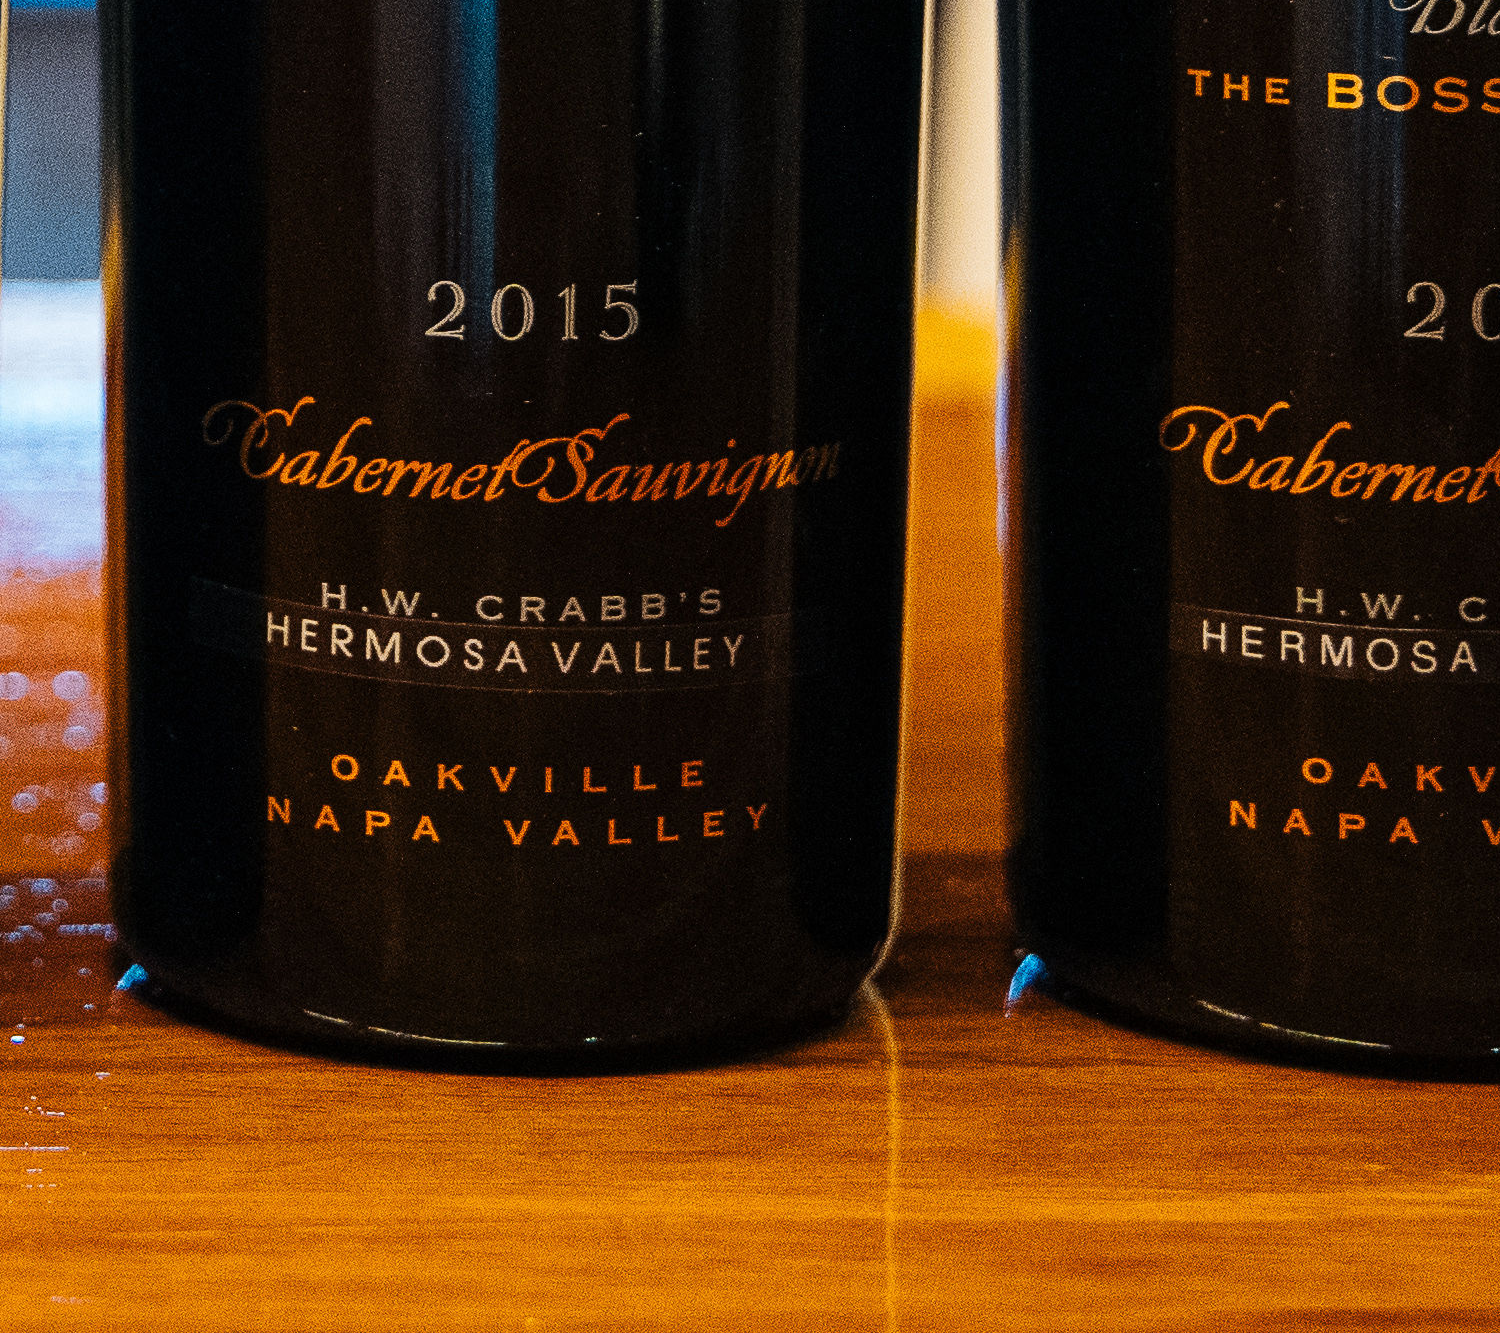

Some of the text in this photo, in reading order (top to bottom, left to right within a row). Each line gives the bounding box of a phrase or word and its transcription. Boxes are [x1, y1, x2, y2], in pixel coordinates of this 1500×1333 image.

[1187, 68, 1291, 105] THE
[425, 279, 640, 342] 2015
[202, 395, 842, 528] Cabernet Sauvignon
[320, 582, 722, 623] H.W. CRABB'S
[1296, 586, 1421, 621] H.W.
[267, 611, 745, 674] HERMOSA VALLEY
[1202, 619, 1478, 673] HERMOSA
[331, 753, 704, 793] OAKVILLE
[267, 796, 769, 845] NAPA VALLEY
[1229, 800, 1419, 844] NAPA
